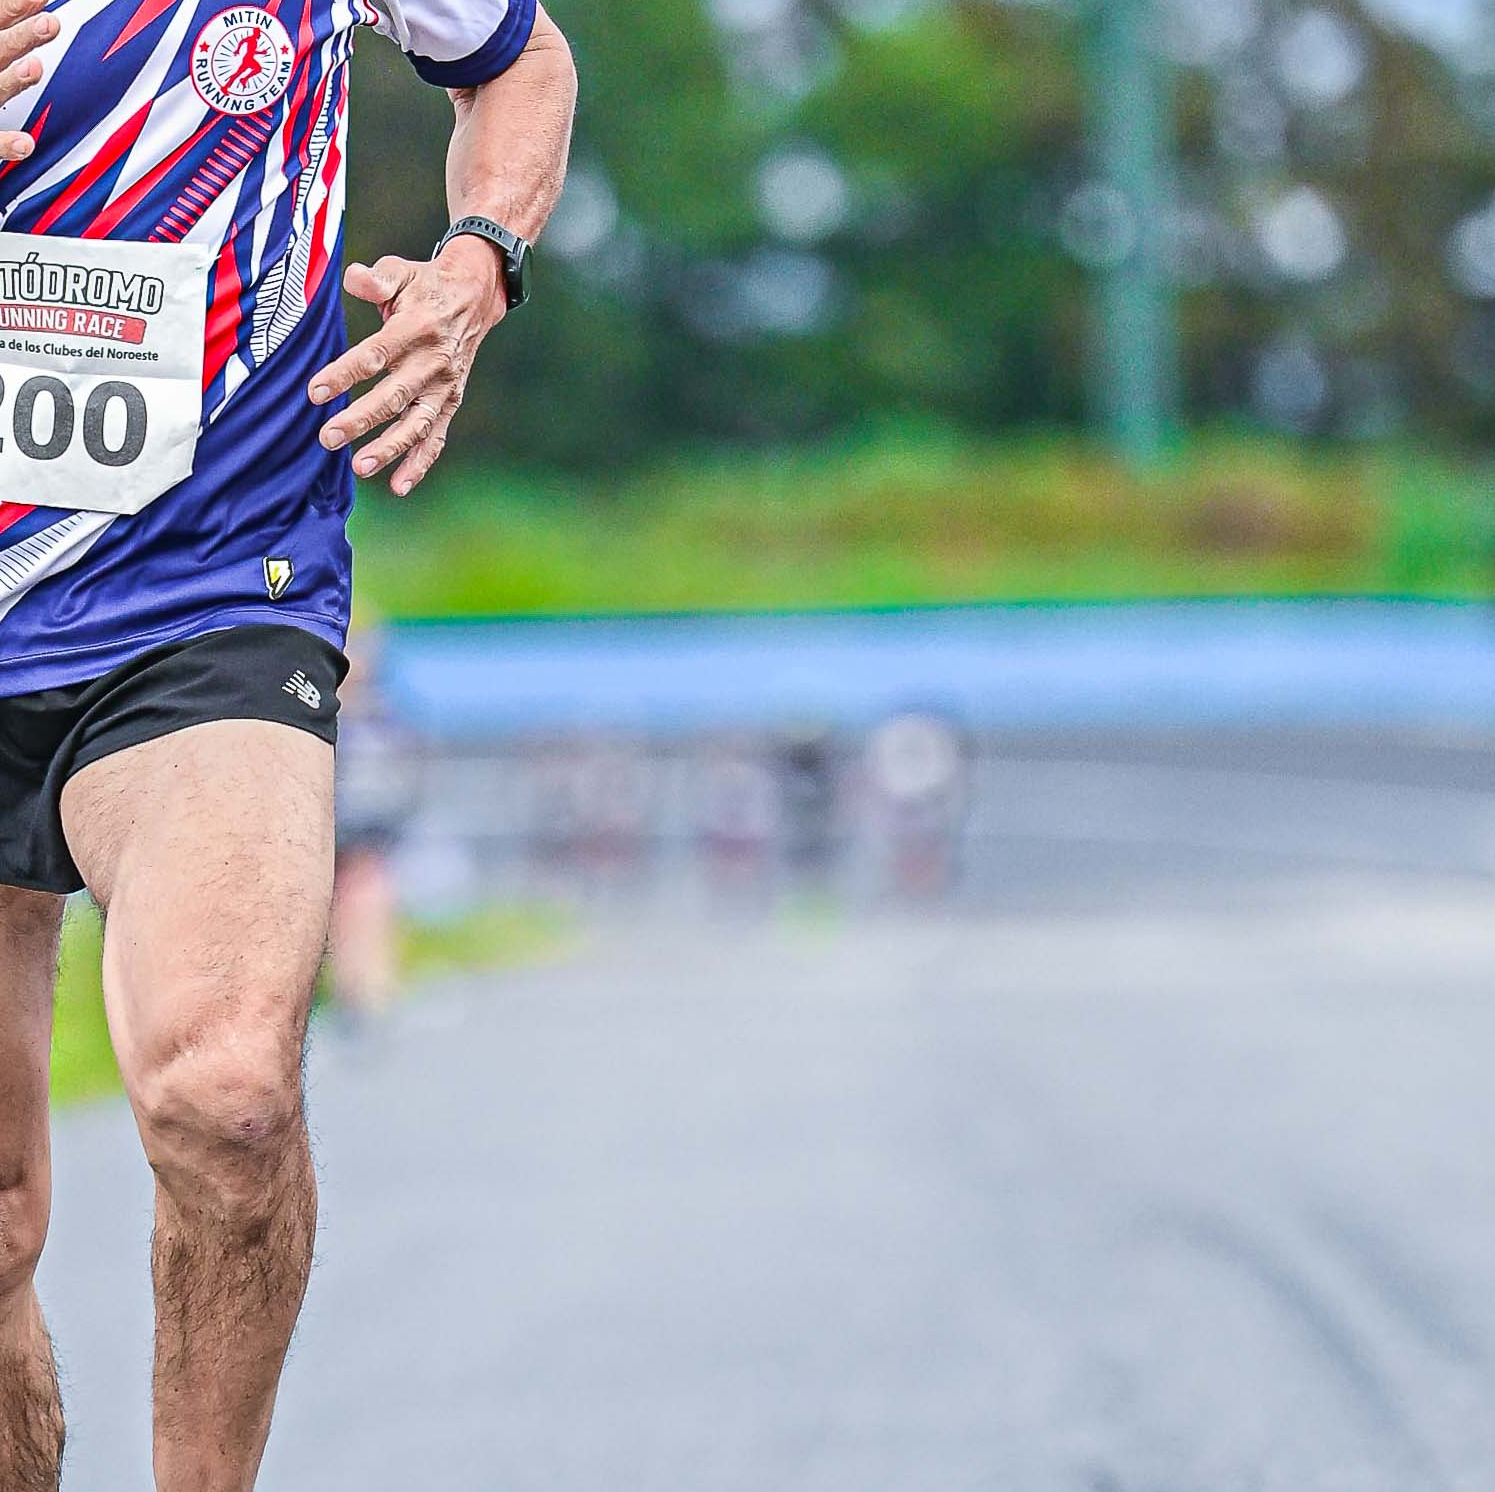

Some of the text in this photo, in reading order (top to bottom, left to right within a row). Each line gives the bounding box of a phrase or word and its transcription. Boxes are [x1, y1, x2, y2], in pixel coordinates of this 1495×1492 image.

[223, 11, 272, 29] MITIN
[196, 58, 292, 111] RUNNING TEAM
[73, 311, 126, 339] RACE
[8, 339, 22, 351] de
[25, 340, 41, 353] los
[44, 342, 83, 357] Clubes
[86, 346, 104, 358] del
[107, 348, 159, 361] Noroeste
